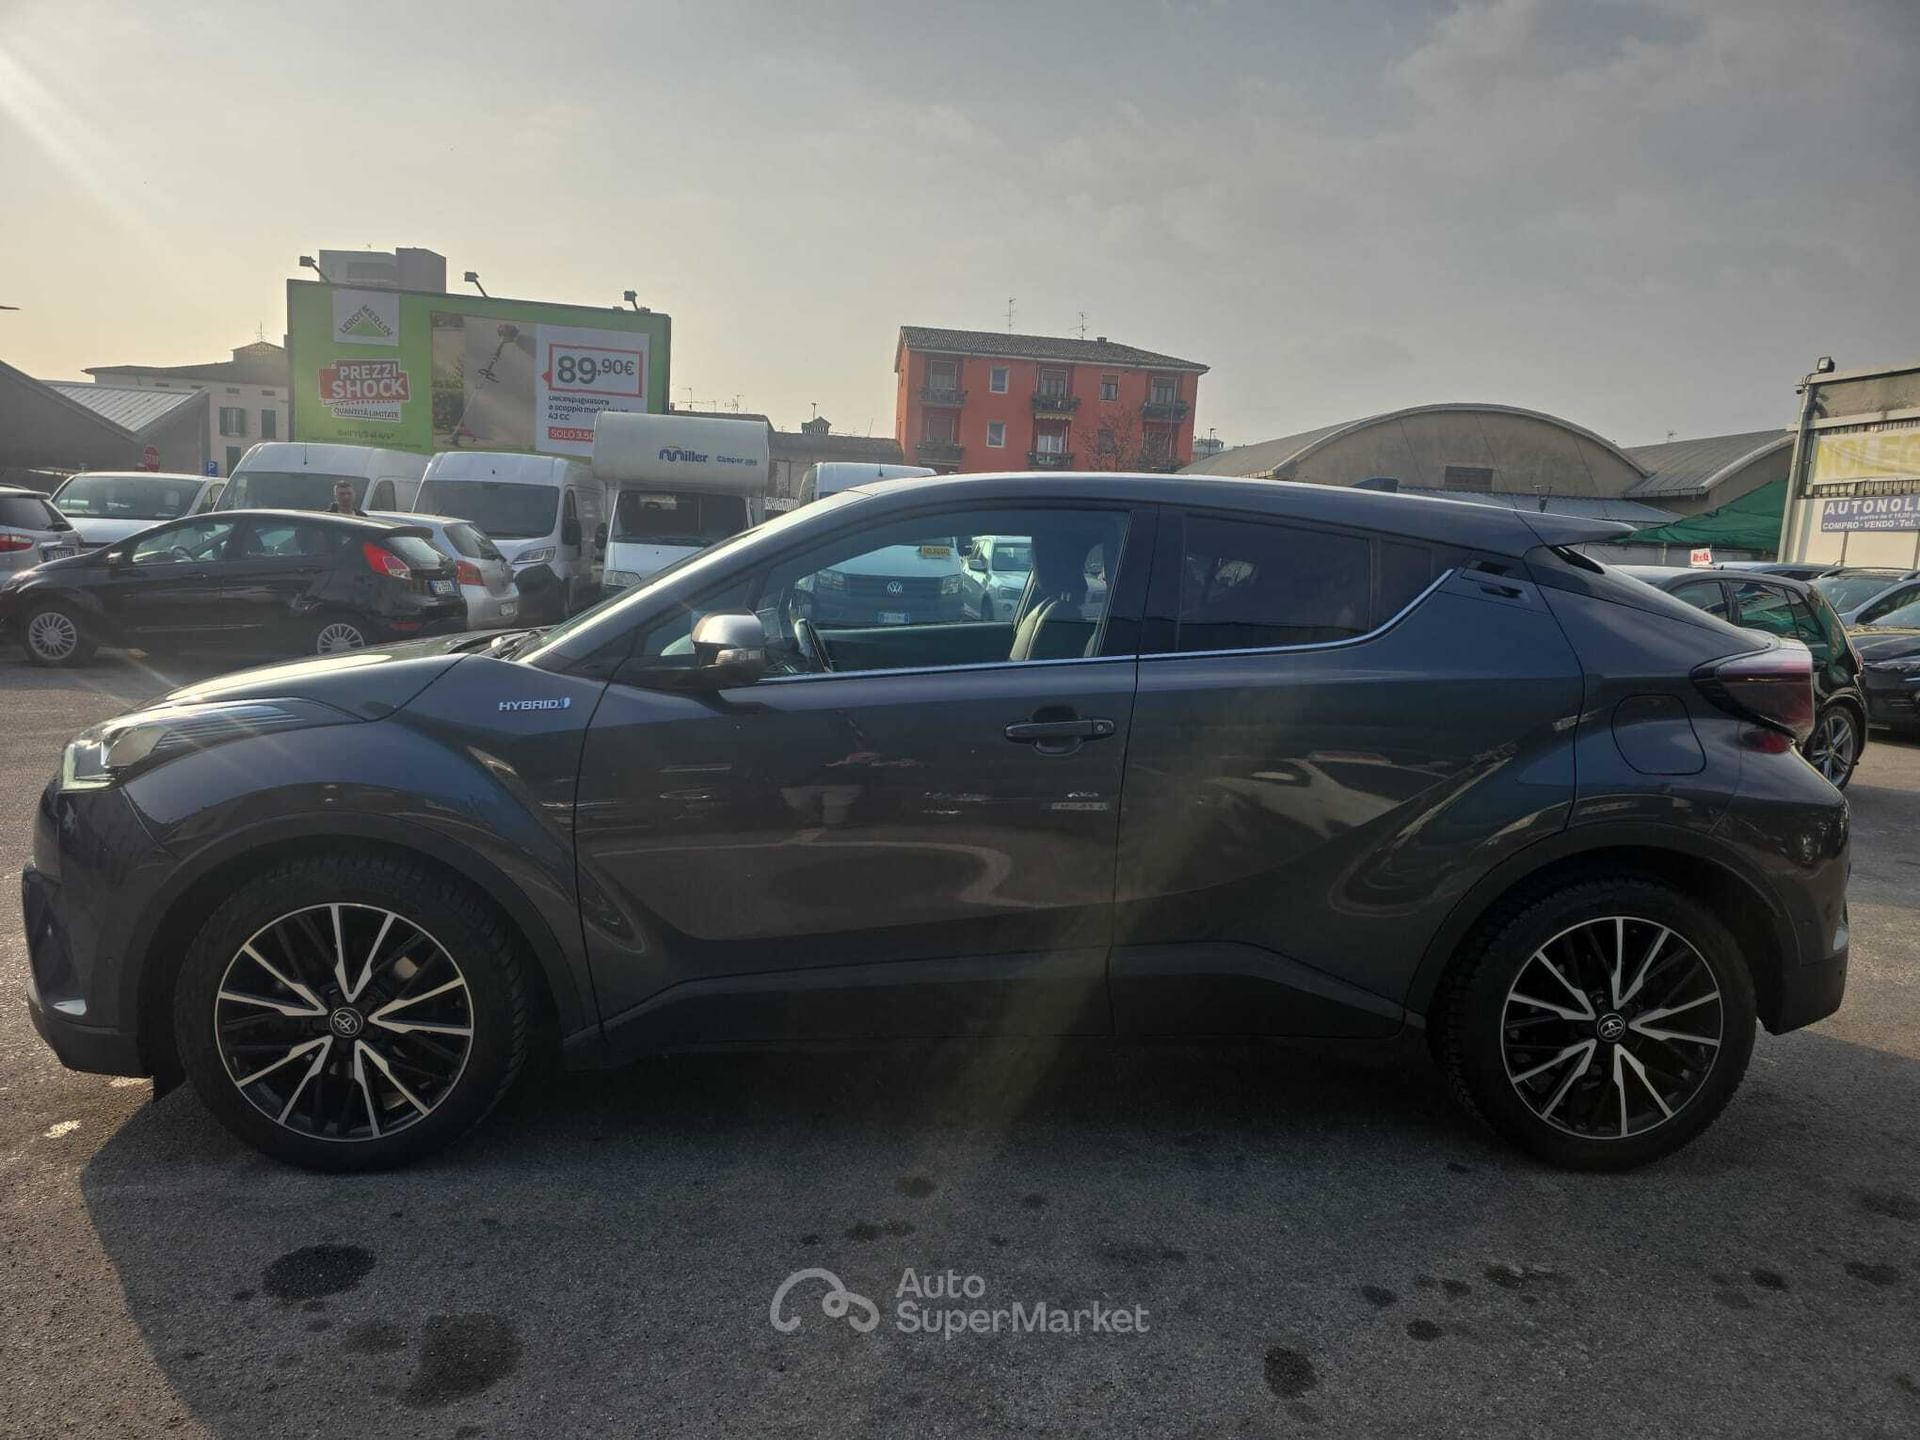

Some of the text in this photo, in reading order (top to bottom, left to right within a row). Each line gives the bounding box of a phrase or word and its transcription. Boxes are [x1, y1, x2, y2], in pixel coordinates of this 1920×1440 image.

[338, 303, 393, 337] LEROY MERLIN
[340, 363, 397, 380] PREZZI
[557, 355, 635, 385] 89,90€
[331, 378, 406, 398] SHOCK
[369, 410, 399, 418] LIMITATE
[551, 428, 576, 438] SOLO
[1822, 521, 1860, 530] COMPRO
[1864, 519, 1894, 529] VENDO
[498, 699, 559, 712] HYBRID
